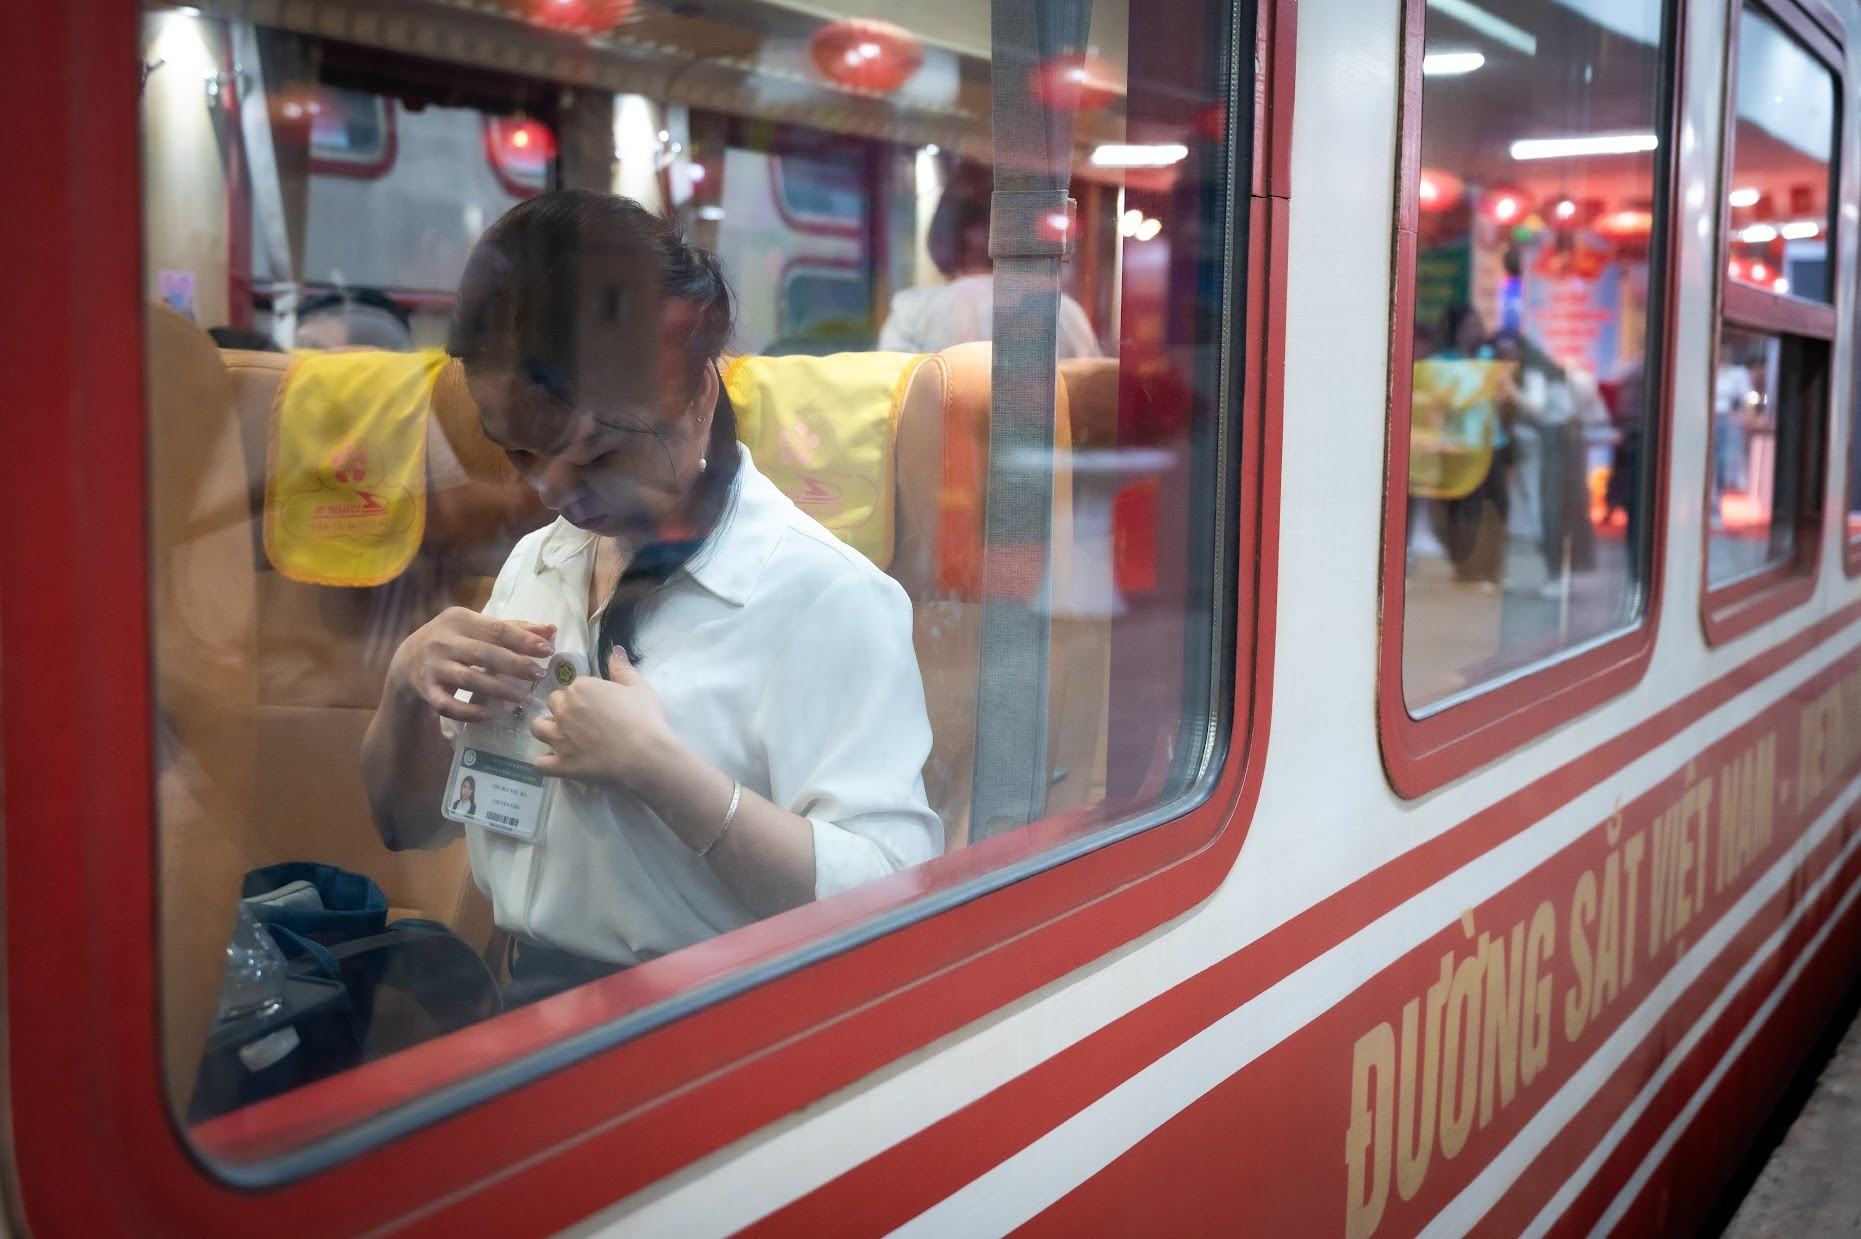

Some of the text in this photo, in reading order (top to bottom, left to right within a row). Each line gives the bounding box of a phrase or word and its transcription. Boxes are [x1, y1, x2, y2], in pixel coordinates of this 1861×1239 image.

[1345, 900, 1556, 1239] ĐƯỜNG
[1565, 794, 1645, 1042] SẮT
[1649, 758, 1712, 964] VIỆT
[1715, 732, 1776, 894] NAM
